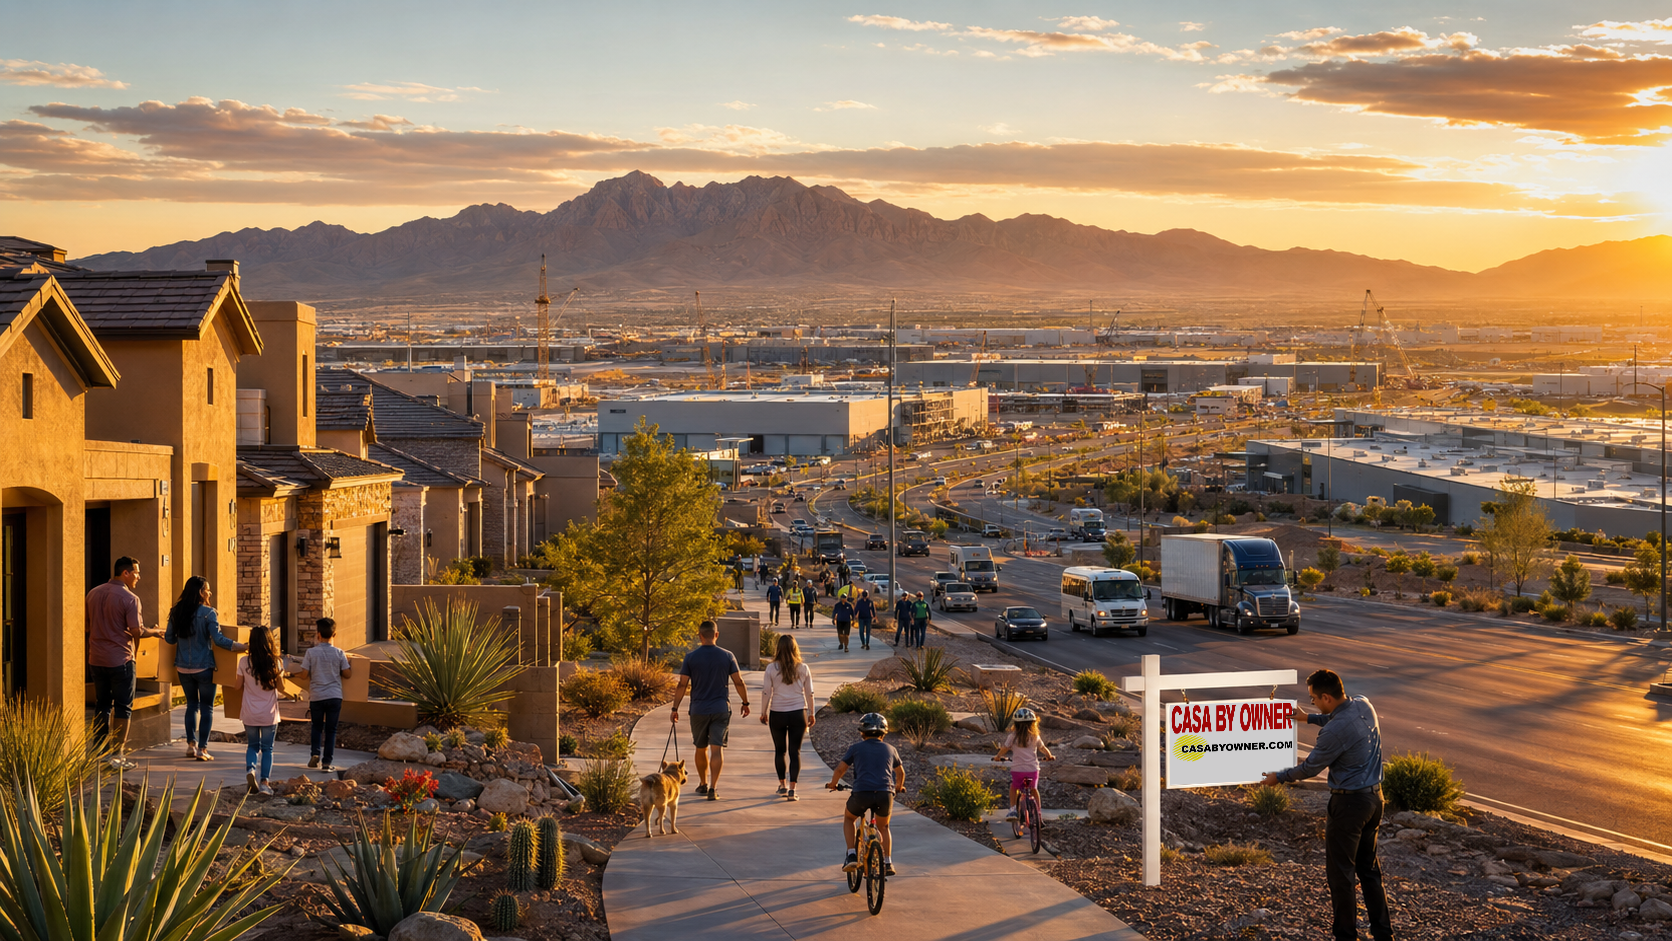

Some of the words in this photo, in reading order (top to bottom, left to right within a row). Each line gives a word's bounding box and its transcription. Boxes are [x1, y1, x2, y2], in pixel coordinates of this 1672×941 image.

[1171, 705, 1212, 734] CASA
[1215, 704, 1237, 732] BY
[1239, 703, 1293, 732] OWNER
[1181, 741, 1293, 753] CASABYOWNER.COM
